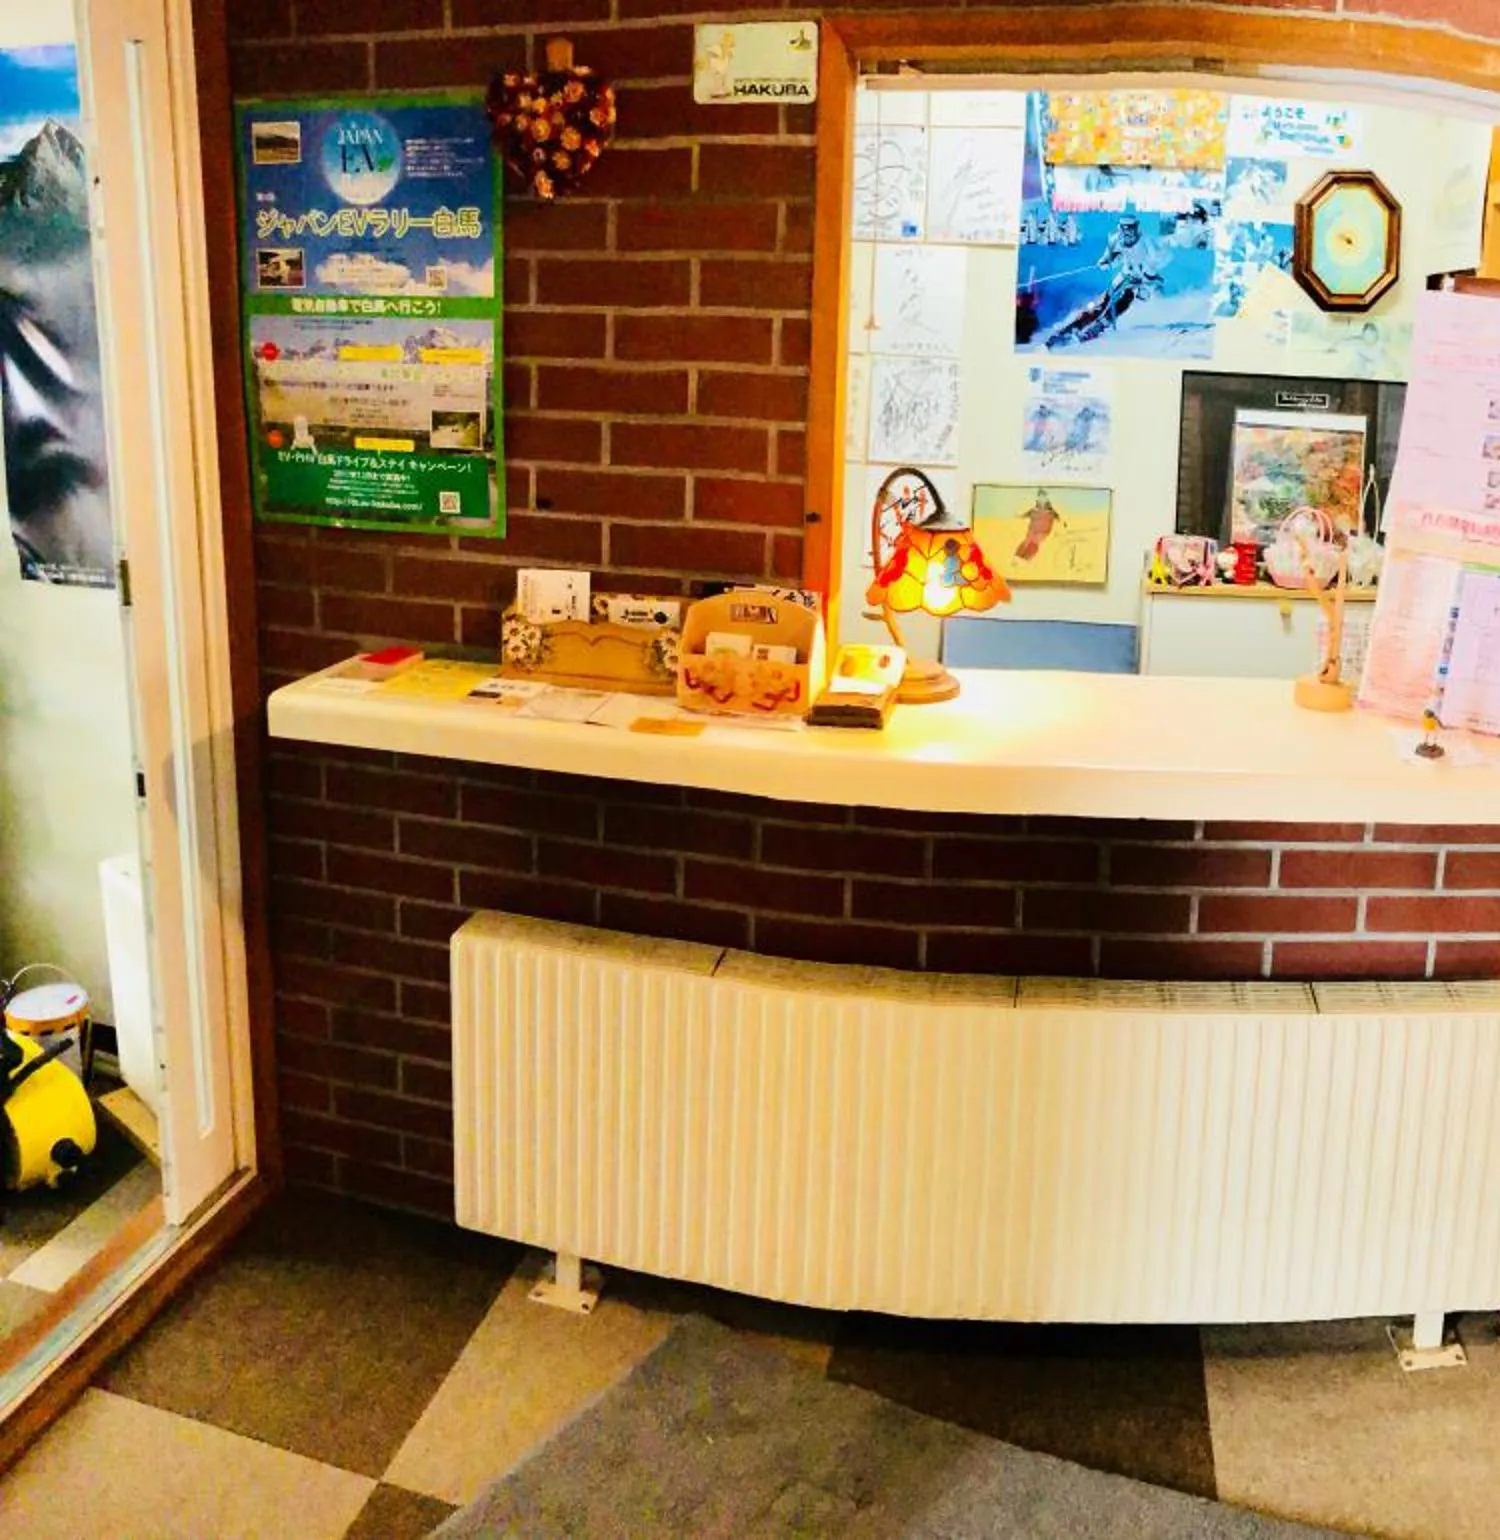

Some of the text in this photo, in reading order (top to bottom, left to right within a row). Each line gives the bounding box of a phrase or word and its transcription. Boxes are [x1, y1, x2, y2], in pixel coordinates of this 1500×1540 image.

[733, 83, 809, 97] HAKUBA
[255, 207, 483, 240] ジャパンEVラリー白馬
